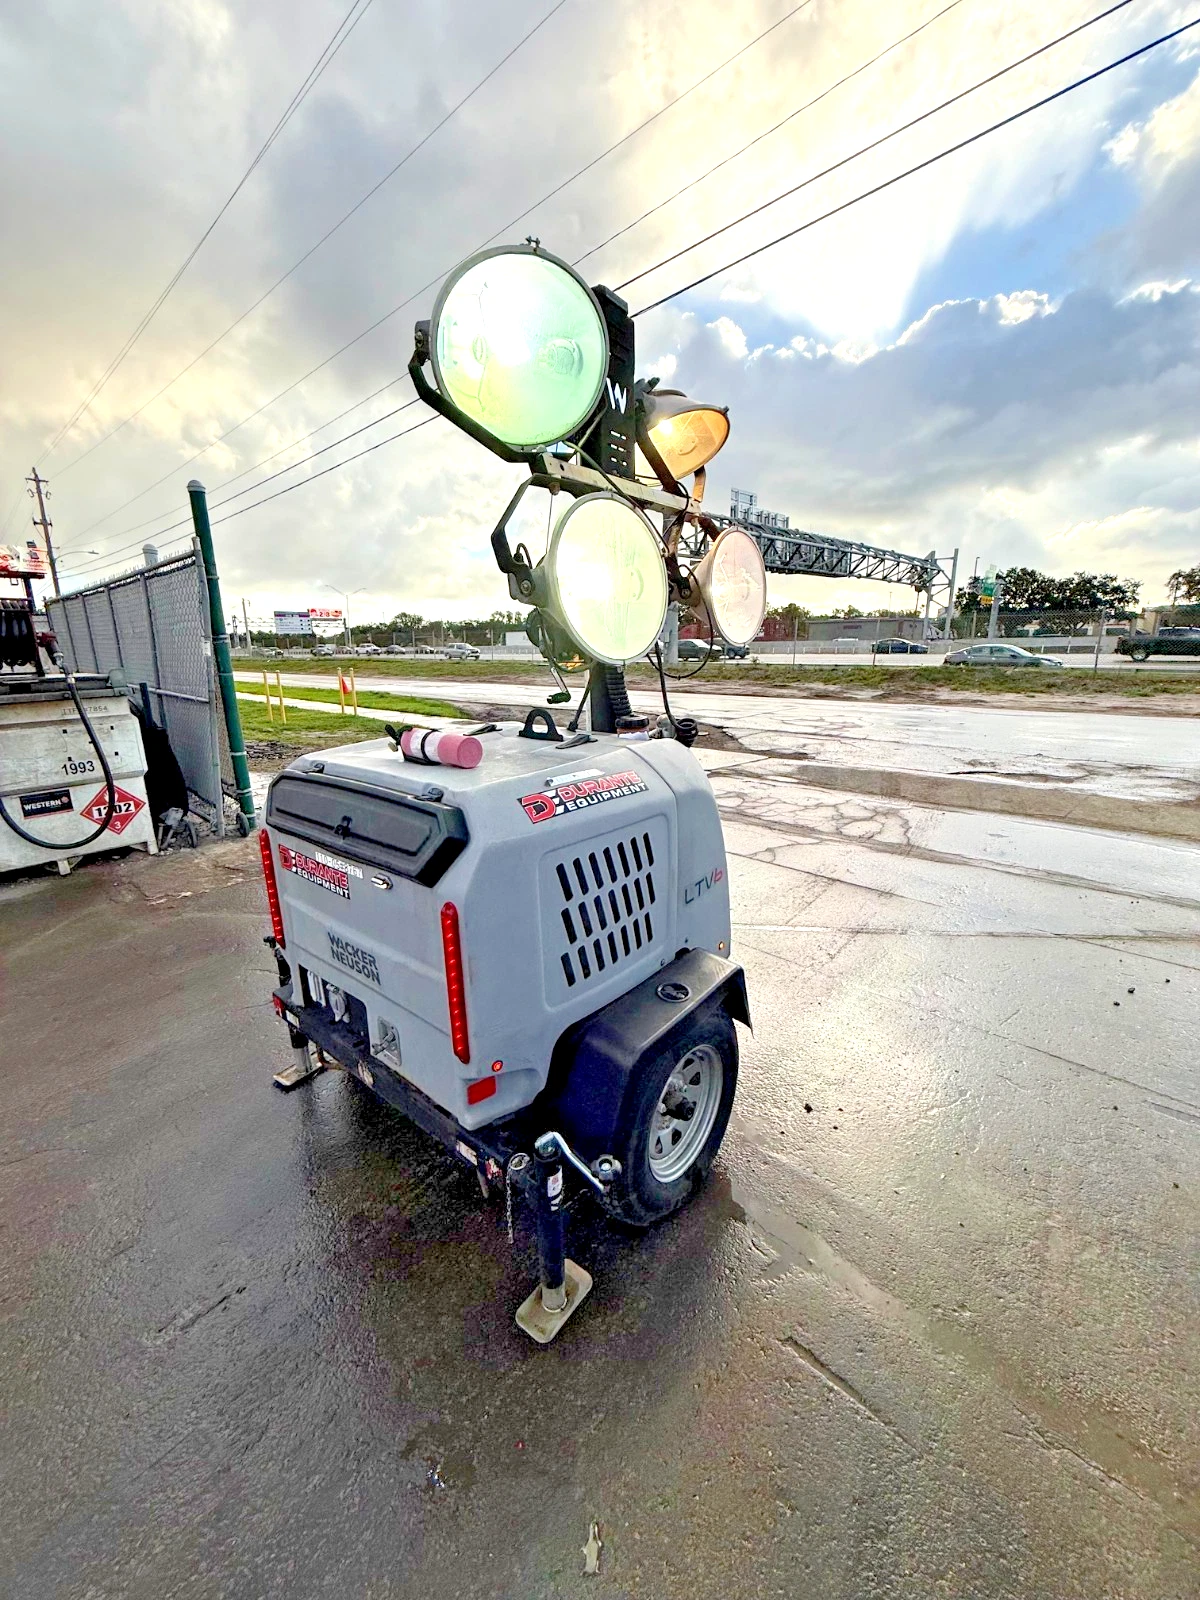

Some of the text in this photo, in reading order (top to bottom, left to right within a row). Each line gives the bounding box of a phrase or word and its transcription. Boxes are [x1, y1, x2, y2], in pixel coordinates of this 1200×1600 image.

[61, 760, 95, 775] 1993
[558, 770, 641, 802] DURANTE
[565, 782, 647, 811] EQUIPMENT
[23, 799, 62, 811] WESTERN
[114, 821, 121, 829] 3
[295, 852, 349, 889] DURANTE
[297, 867, 350, 898] EQUIPMENT
[327, 931, 378, 971] WACKER
[330, 946, 381, 986] NEUSON
